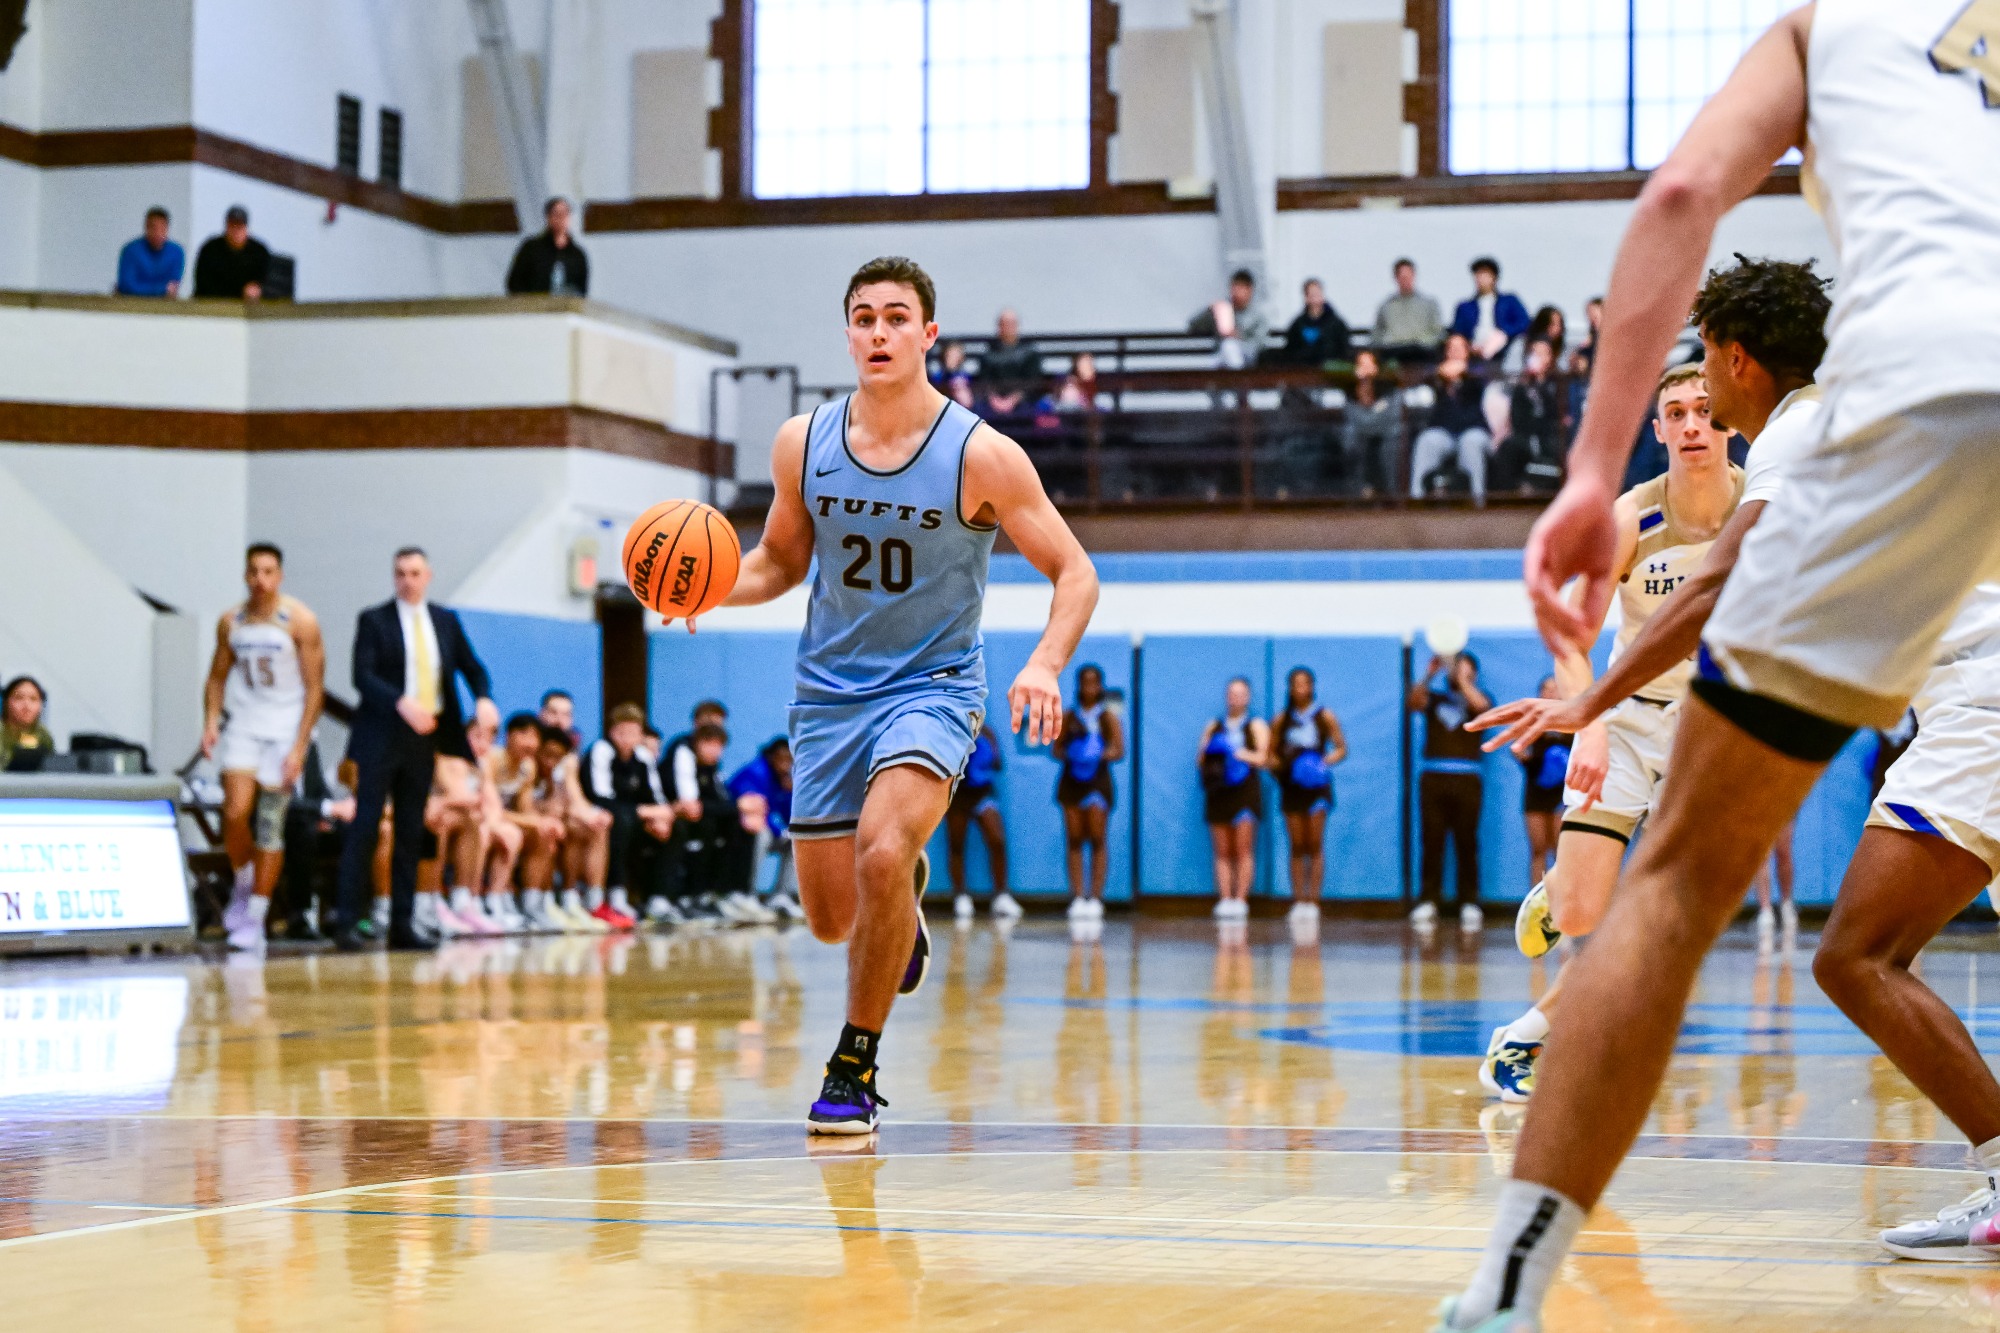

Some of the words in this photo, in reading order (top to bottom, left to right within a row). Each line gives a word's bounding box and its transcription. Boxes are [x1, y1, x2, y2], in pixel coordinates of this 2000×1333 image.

[816, 495, 943, 530] TUFTS
[633, 531, 669, 601] Wilson
[669, 555, 697, 607] NCAA
[842, 534, 912, 594] 20
[33, 890, 49, 920] &
[57, 889, 124, 919] BLUE
